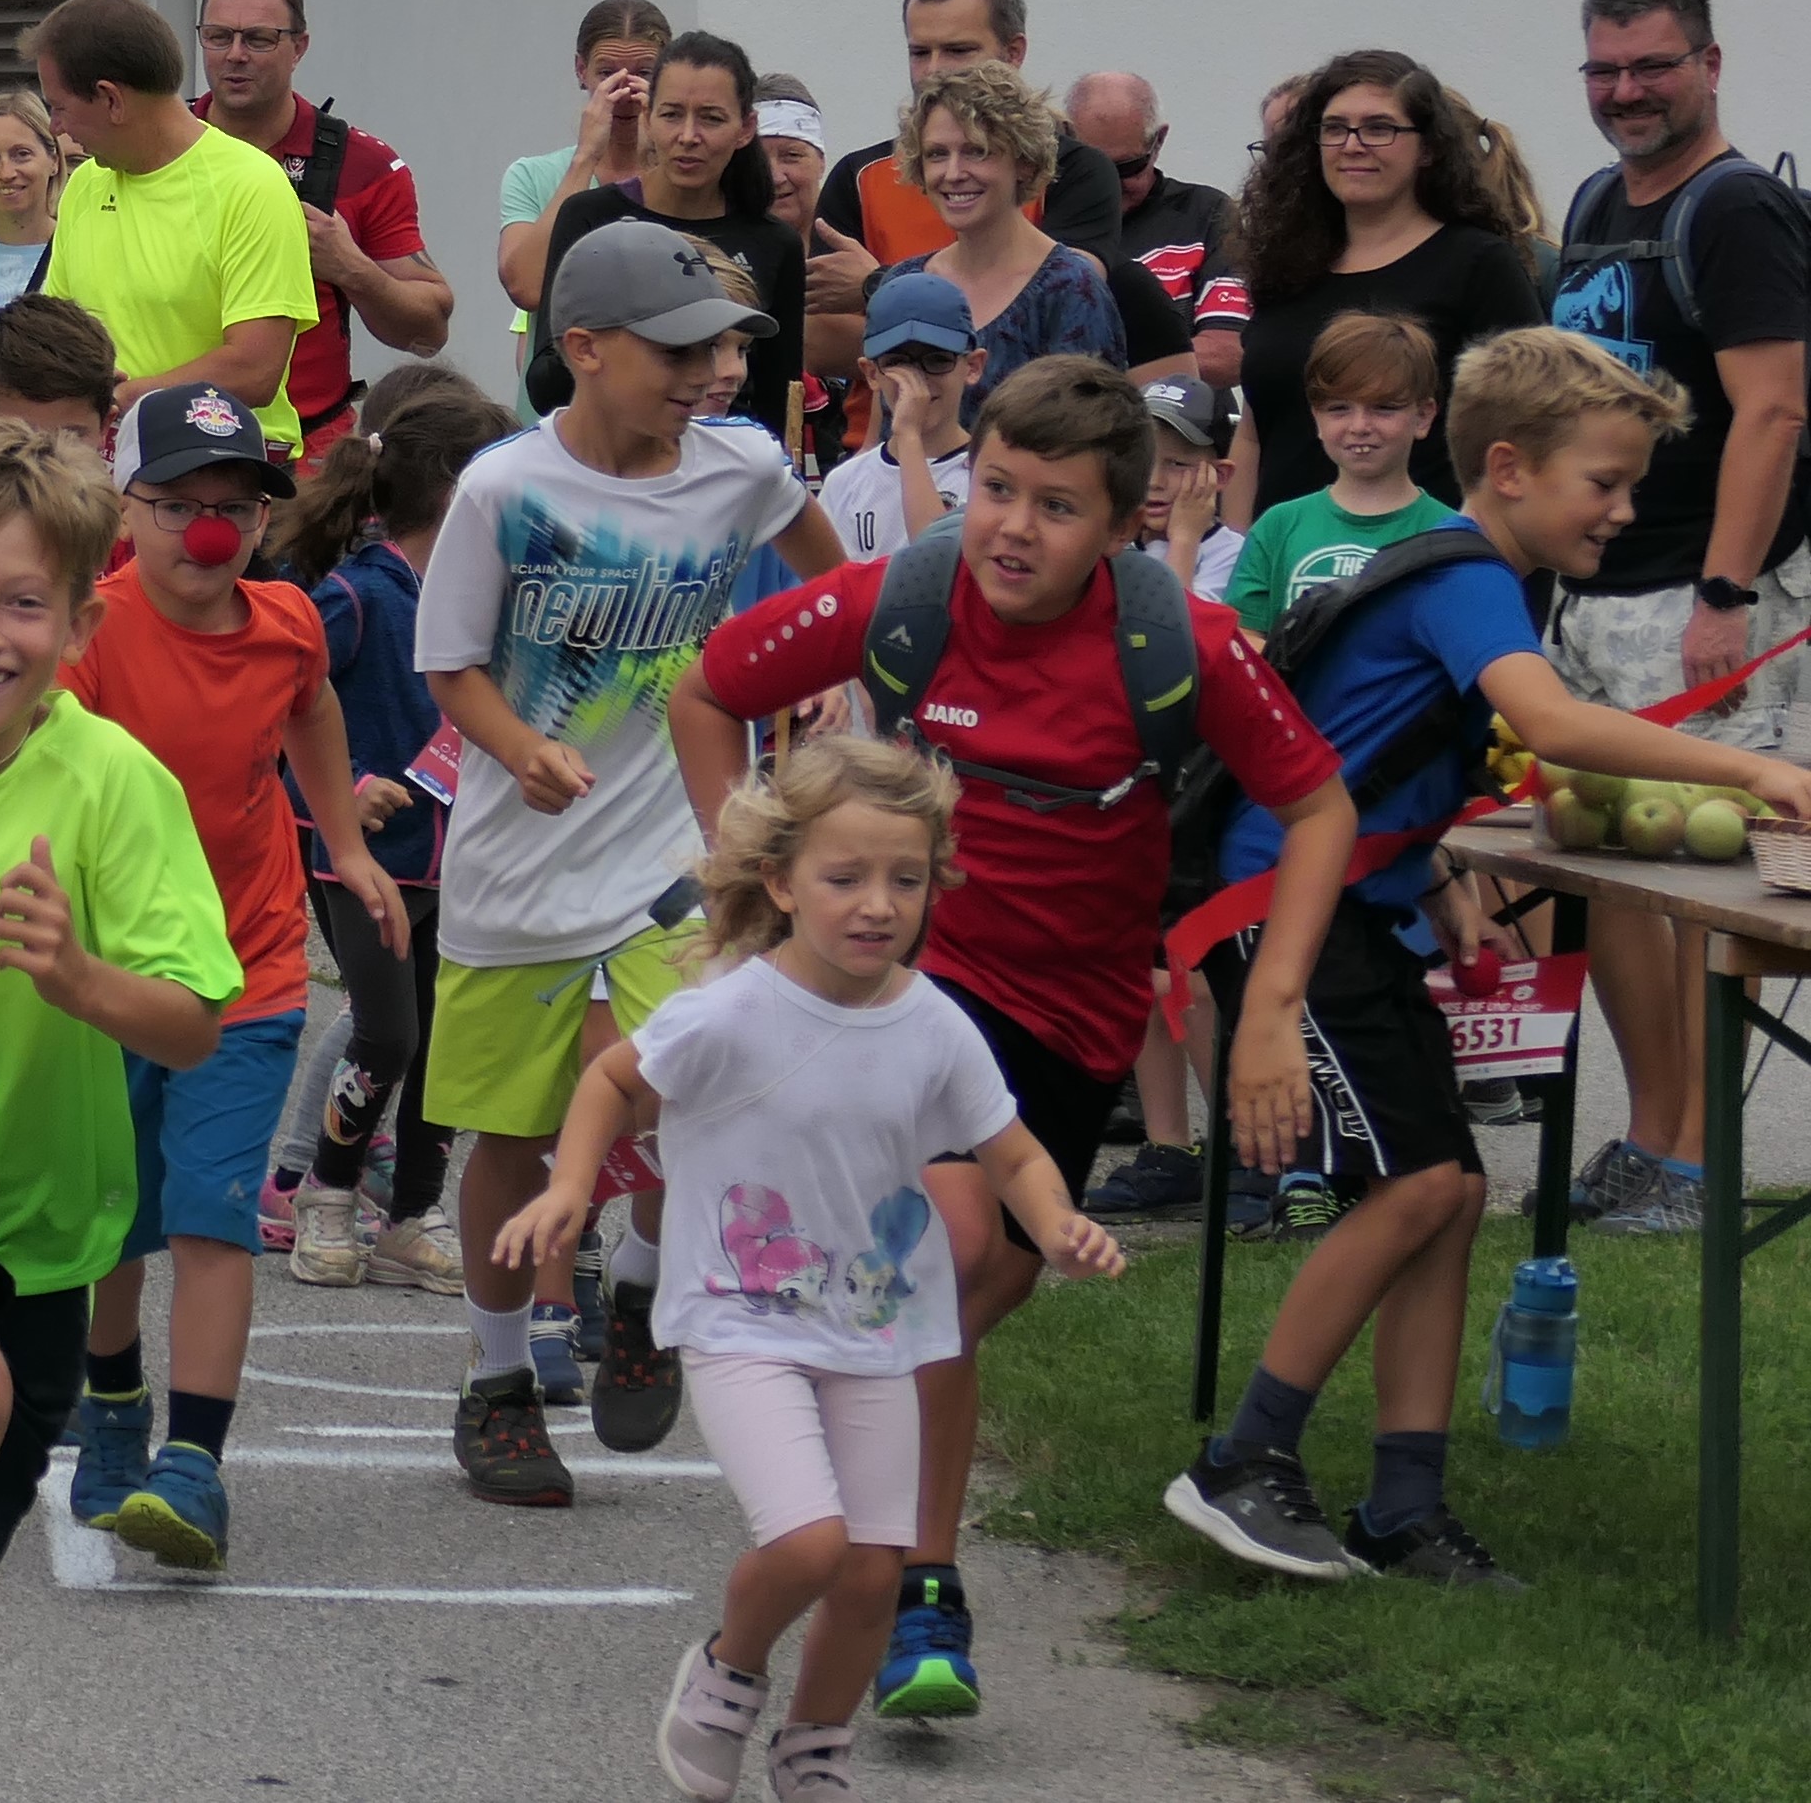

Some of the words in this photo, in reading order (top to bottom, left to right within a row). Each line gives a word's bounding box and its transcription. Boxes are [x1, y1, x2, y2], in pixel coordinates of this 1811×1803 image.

[855, 511, 875, 552] 10
[563, 566, 595, 578] YOUR
[600, 568, 639, 580] SPACE
[924, 703, 978, 727] JAKO
[1451, 1018, 1521, 1052] 6531
